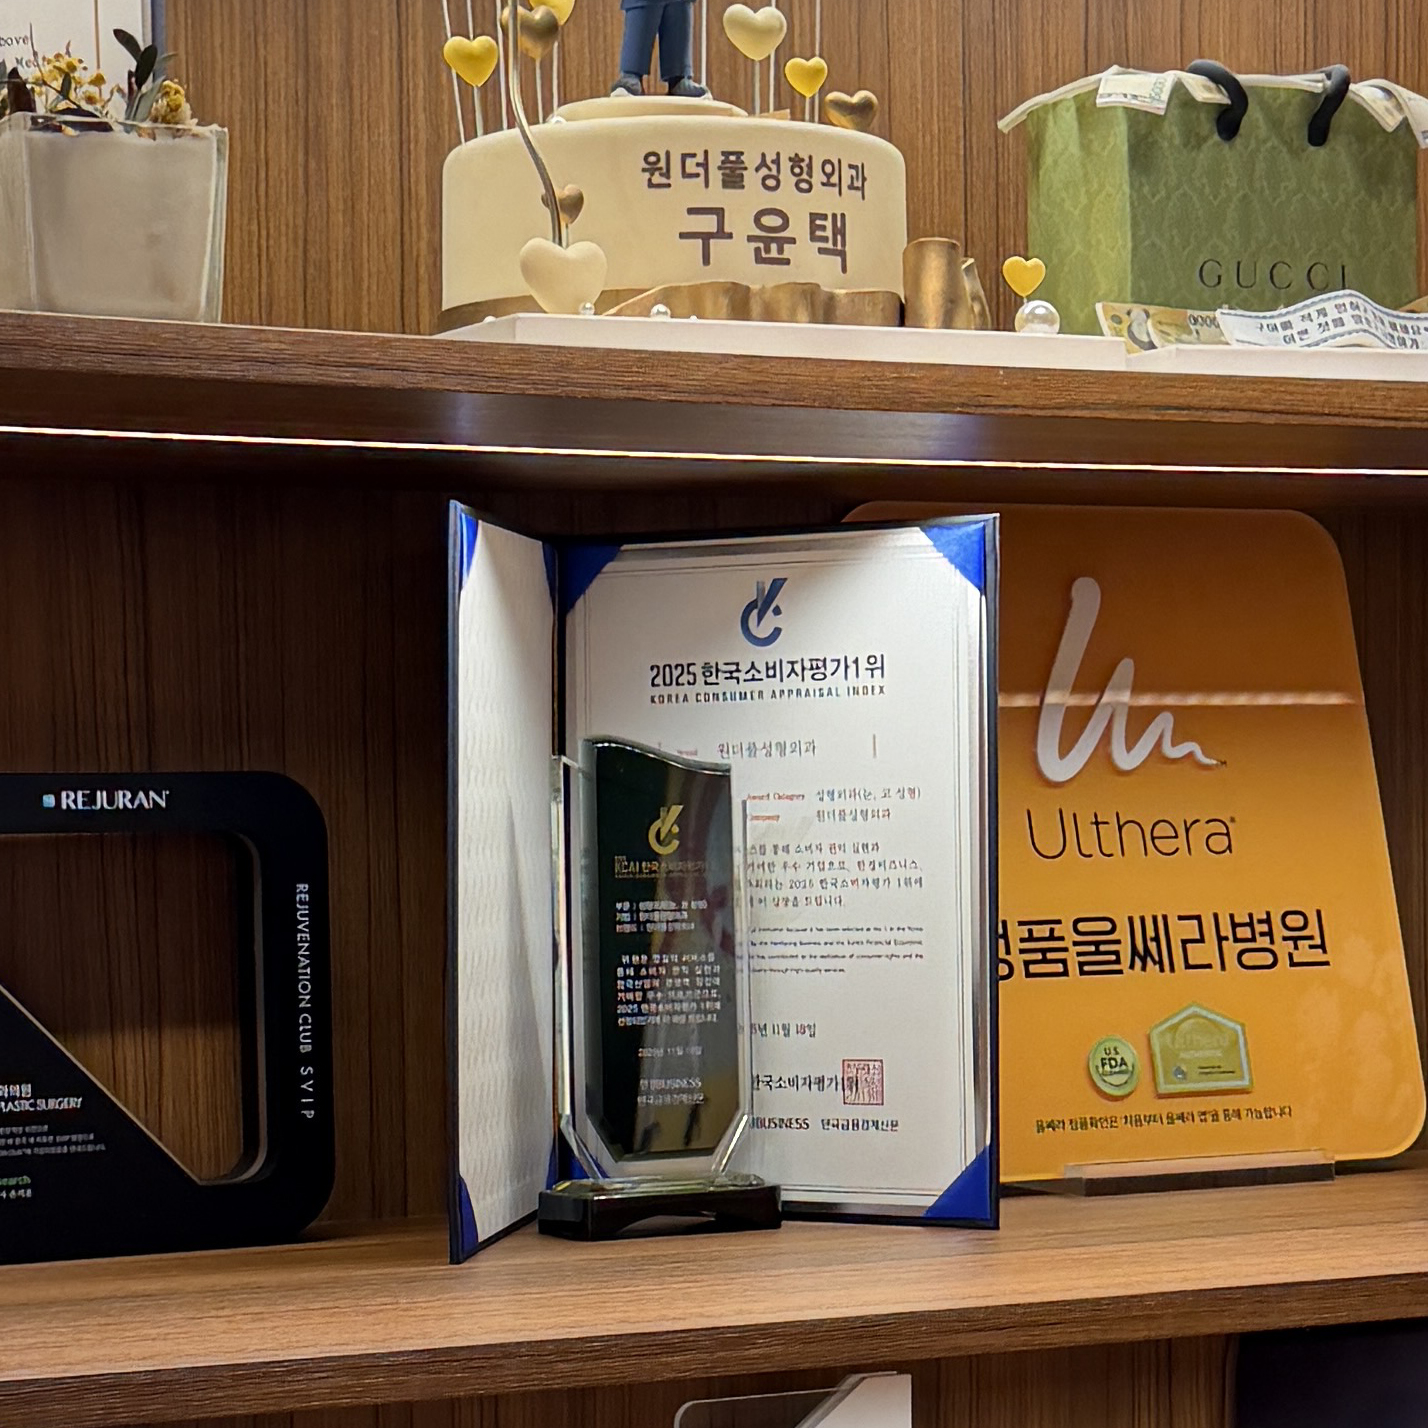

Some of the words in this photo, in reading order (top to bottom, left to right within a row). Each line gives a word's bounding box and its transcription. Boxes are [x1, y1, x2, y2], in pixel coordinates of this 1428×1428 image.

[640, 150, 868, 201] 원더풀성형외과
[678, 206, 850, 274] 구윤택
[1198, 258, 1348, 292] GUCCI
[650, 662, 697, 687] 2025
[650, 693, 689, 704] KOREA
[695, 690, 765, 703] CONSUMER
[770, 686, 841, 699] APPRAISAL
[847, 684, 886, 697] INDEX
[60, 789, 169, 811] REJURAN
[1027, 808, 1233, 860] Ulthera
[295, 883, 312, 1009] REJUVENATION
[298, 1012, 313, 1054] CLUB
[1100, 1056, 1128, 1070] FDA
